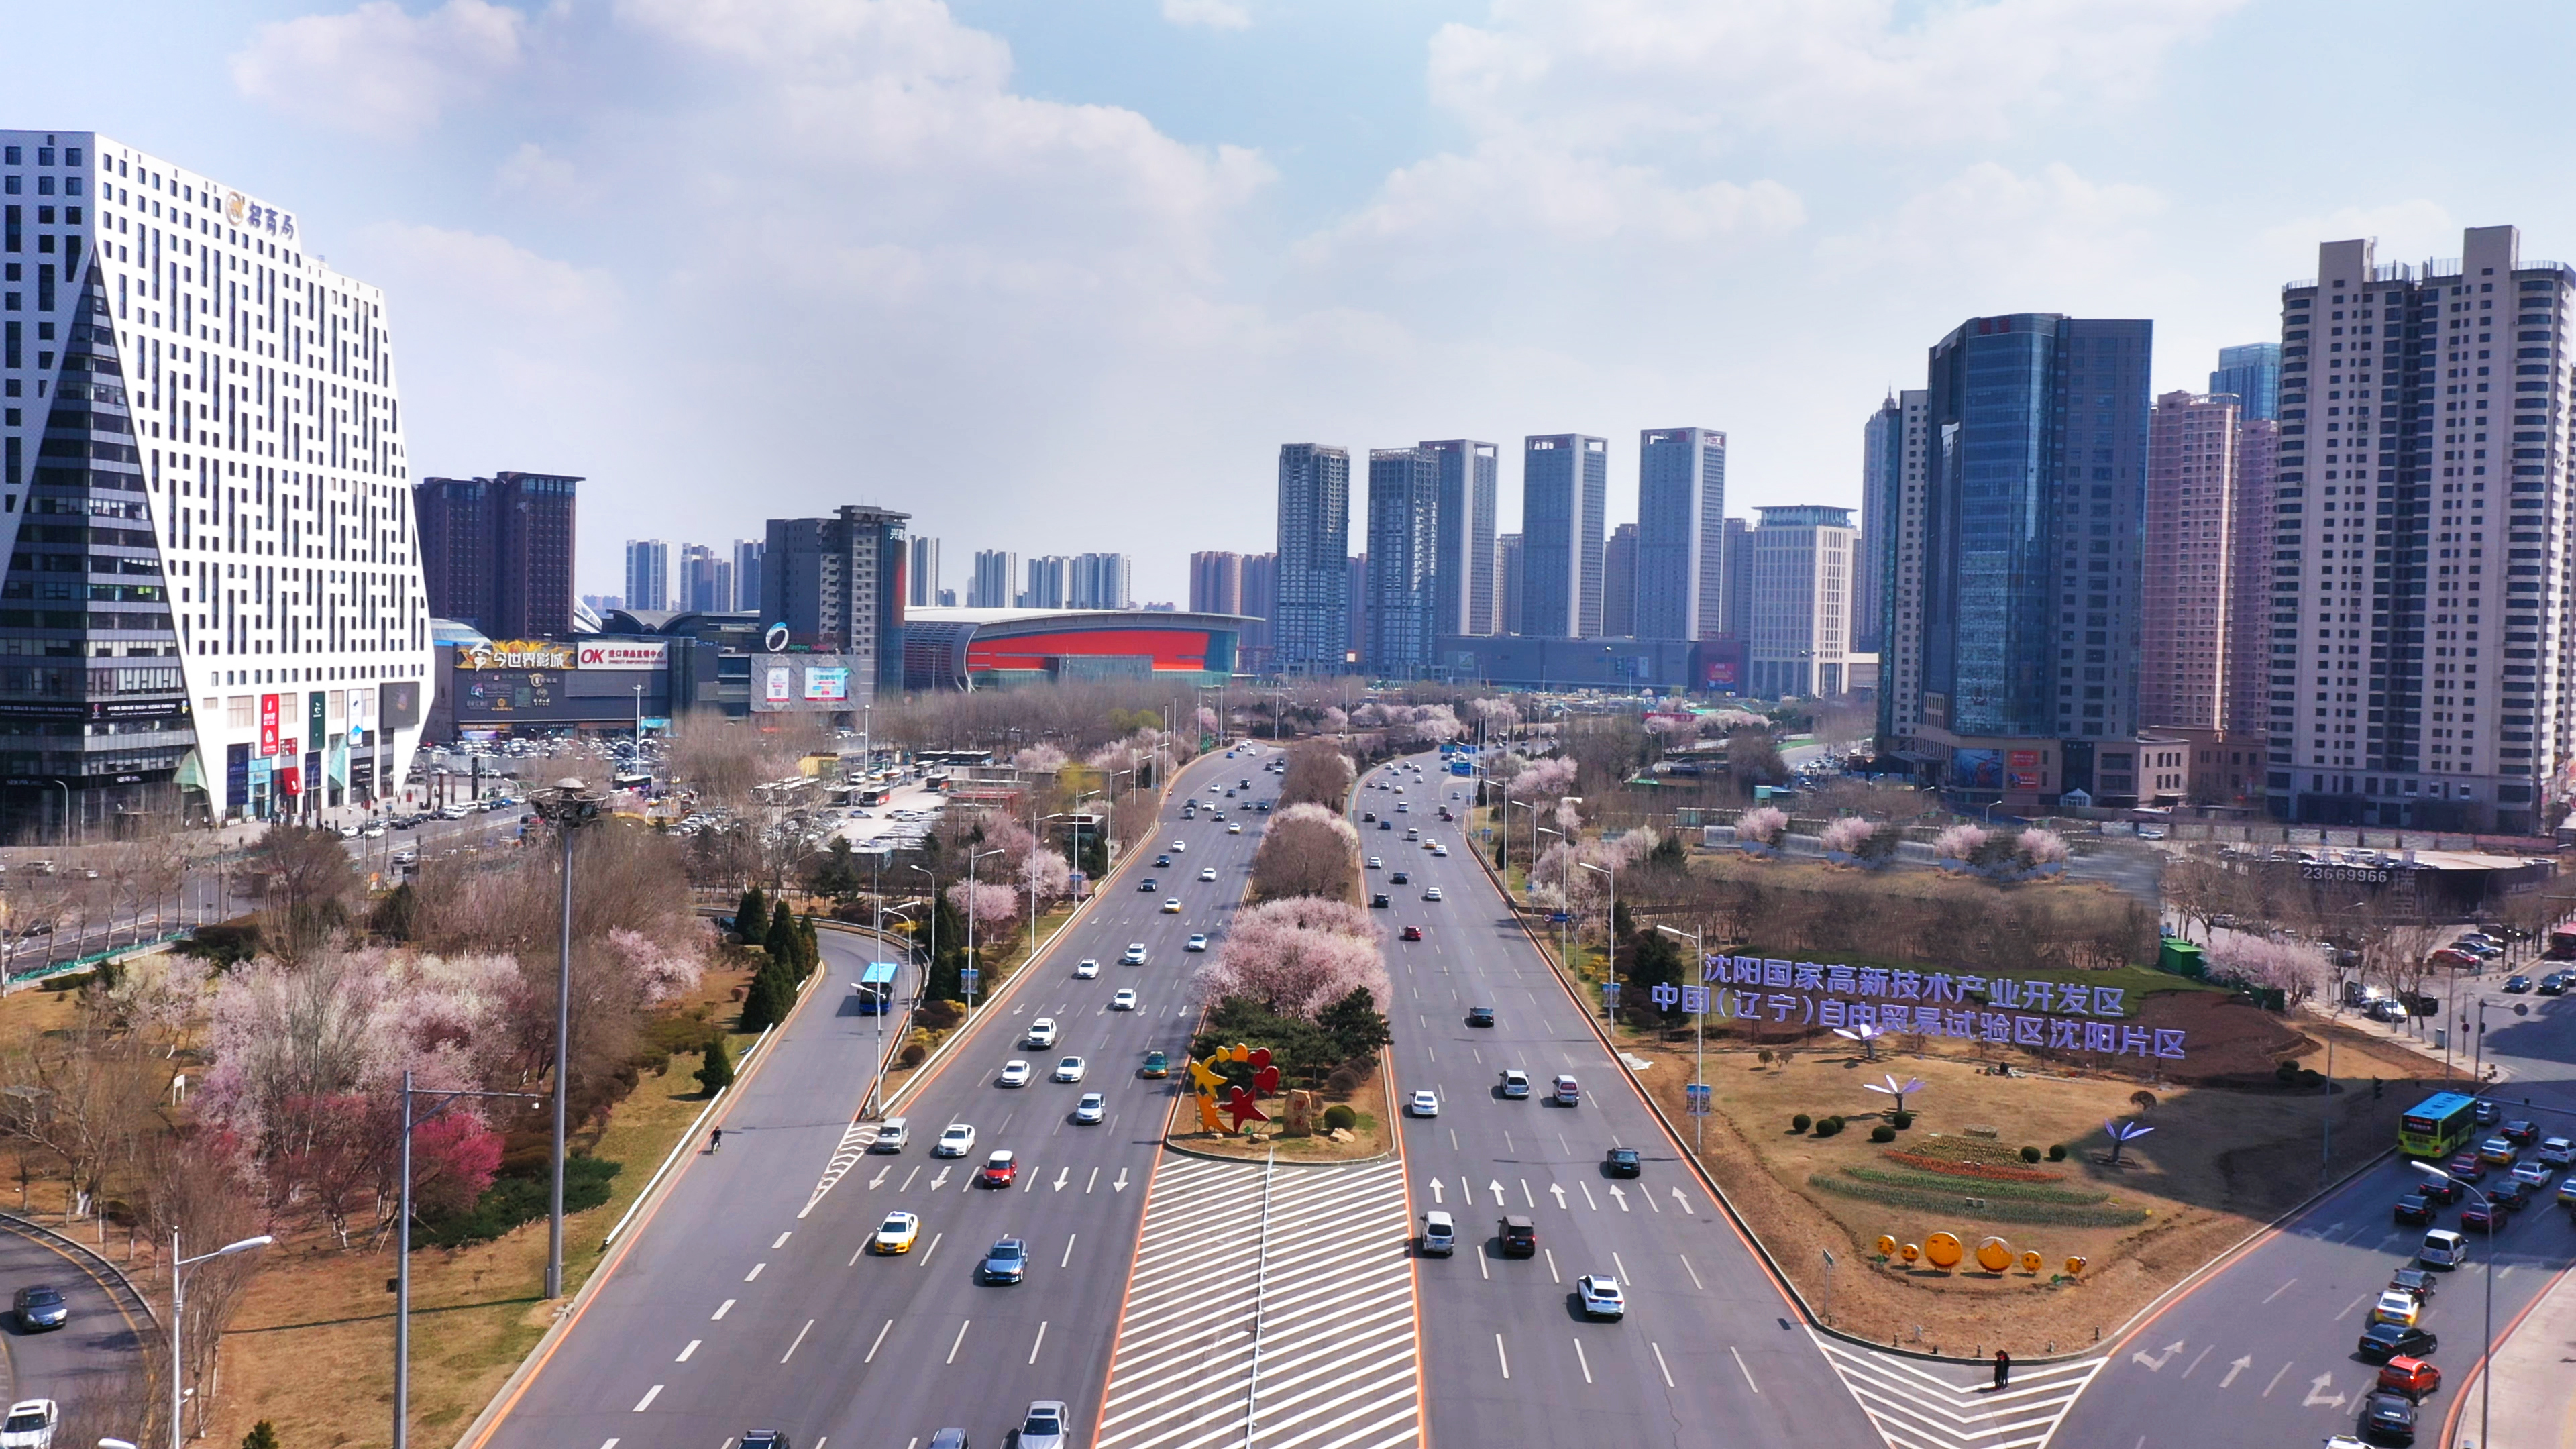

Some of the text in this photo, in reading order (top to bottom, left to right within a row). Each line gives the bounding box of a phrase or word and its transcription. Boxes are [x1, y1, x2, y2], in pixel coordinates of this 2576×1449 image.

[494, 652, 564, 667] 今世界影城
[580, 649, 605, 664] OK
[2303, 867, 2387, 883] 23669966
[1704, 953, 2125, 1017] 沈阳国家高新技术产业开发区
